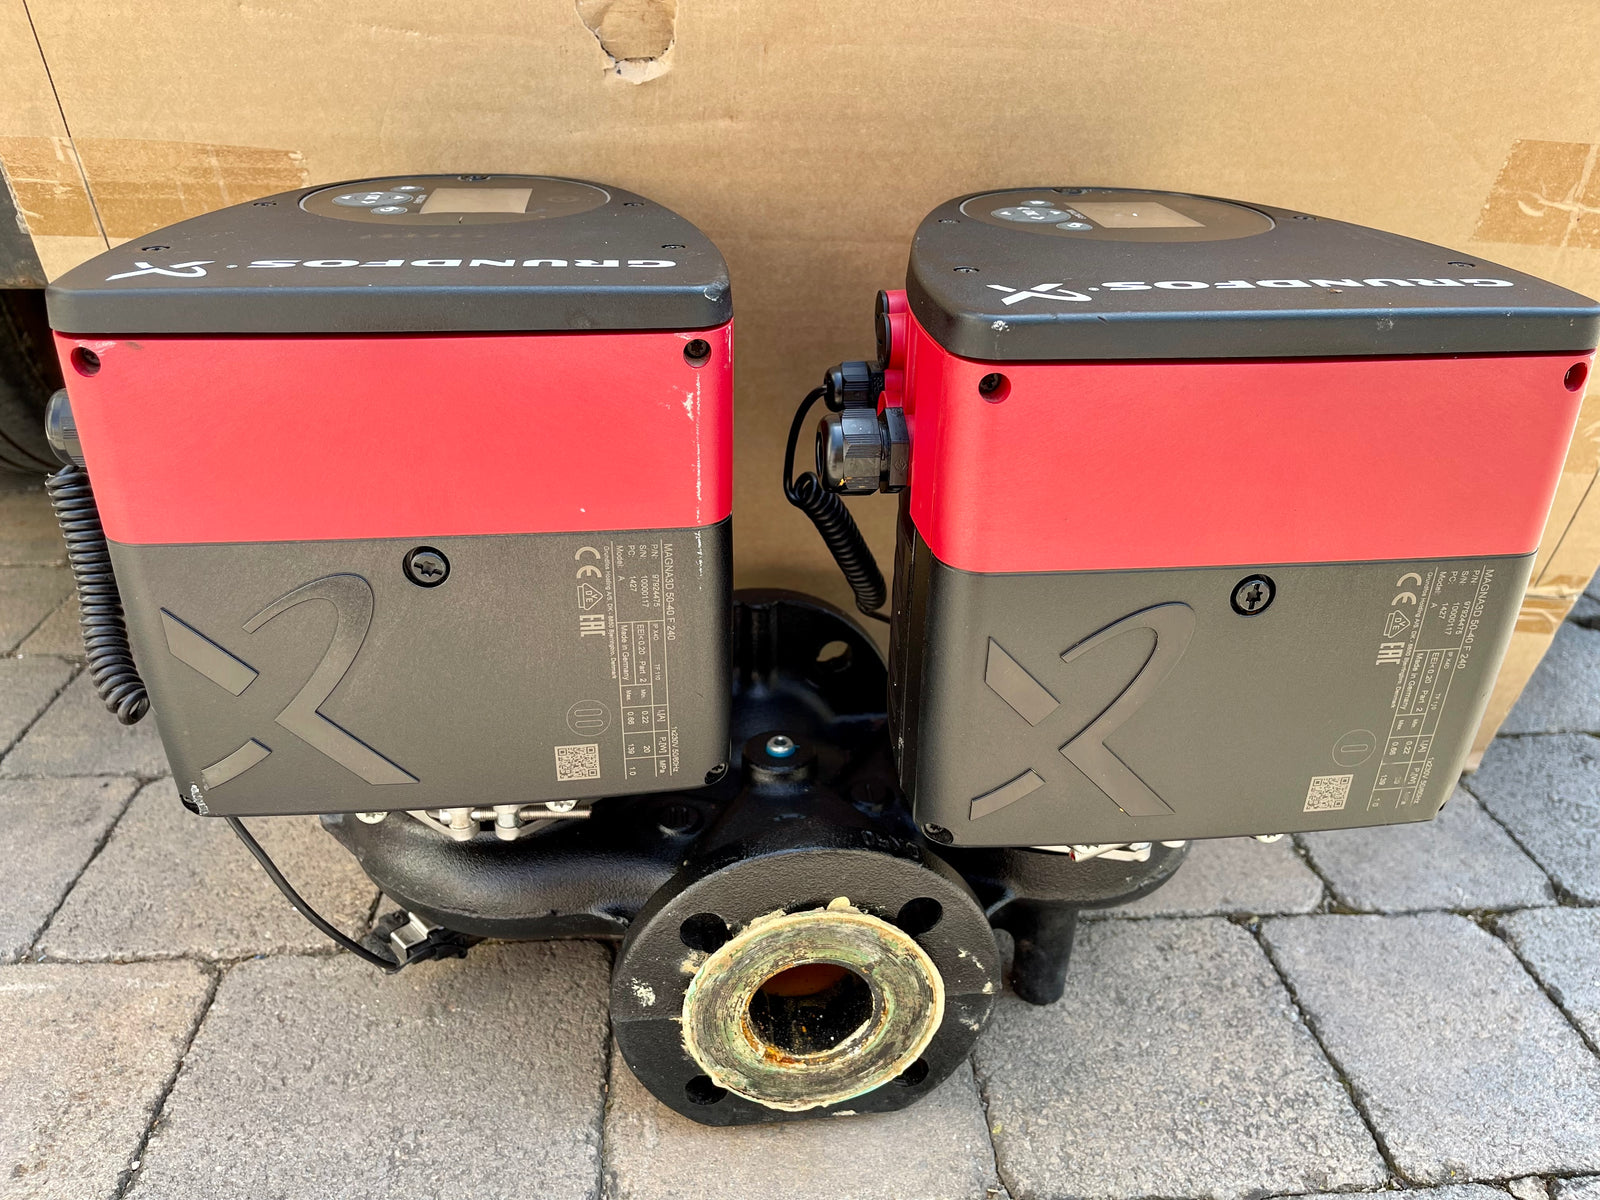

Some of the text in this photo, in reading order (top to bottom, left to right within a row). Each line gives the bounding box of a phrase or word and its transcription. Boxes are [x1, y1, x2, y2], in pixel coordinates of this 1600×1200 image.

[248, 259, 677, 269] GRUNDFOS
[1101, 278, 1515, 291] GRUNDFOS
[664, 544, 674, 589] MAGNA3D
[1435, 571, 1447, 594] Model:
[1473, 569, 1494, 617] MAGNA3D
[666, 592, 674, 615] 50-40
[1439, 603, 1448, 619] 1427
[667, 626, 675, 640] 240
[1465, 619, 1479, 643] 50-40
[621, 652, 630, 680] Germany
[1412, 653, 1424, 671] Made
[1457, 654, 1469, 669] 240
[1400, 680, 1416, 710] Germany
[1418, 690, 1428, 703] Part
[1403, 740, 1412, 755] 0.22
